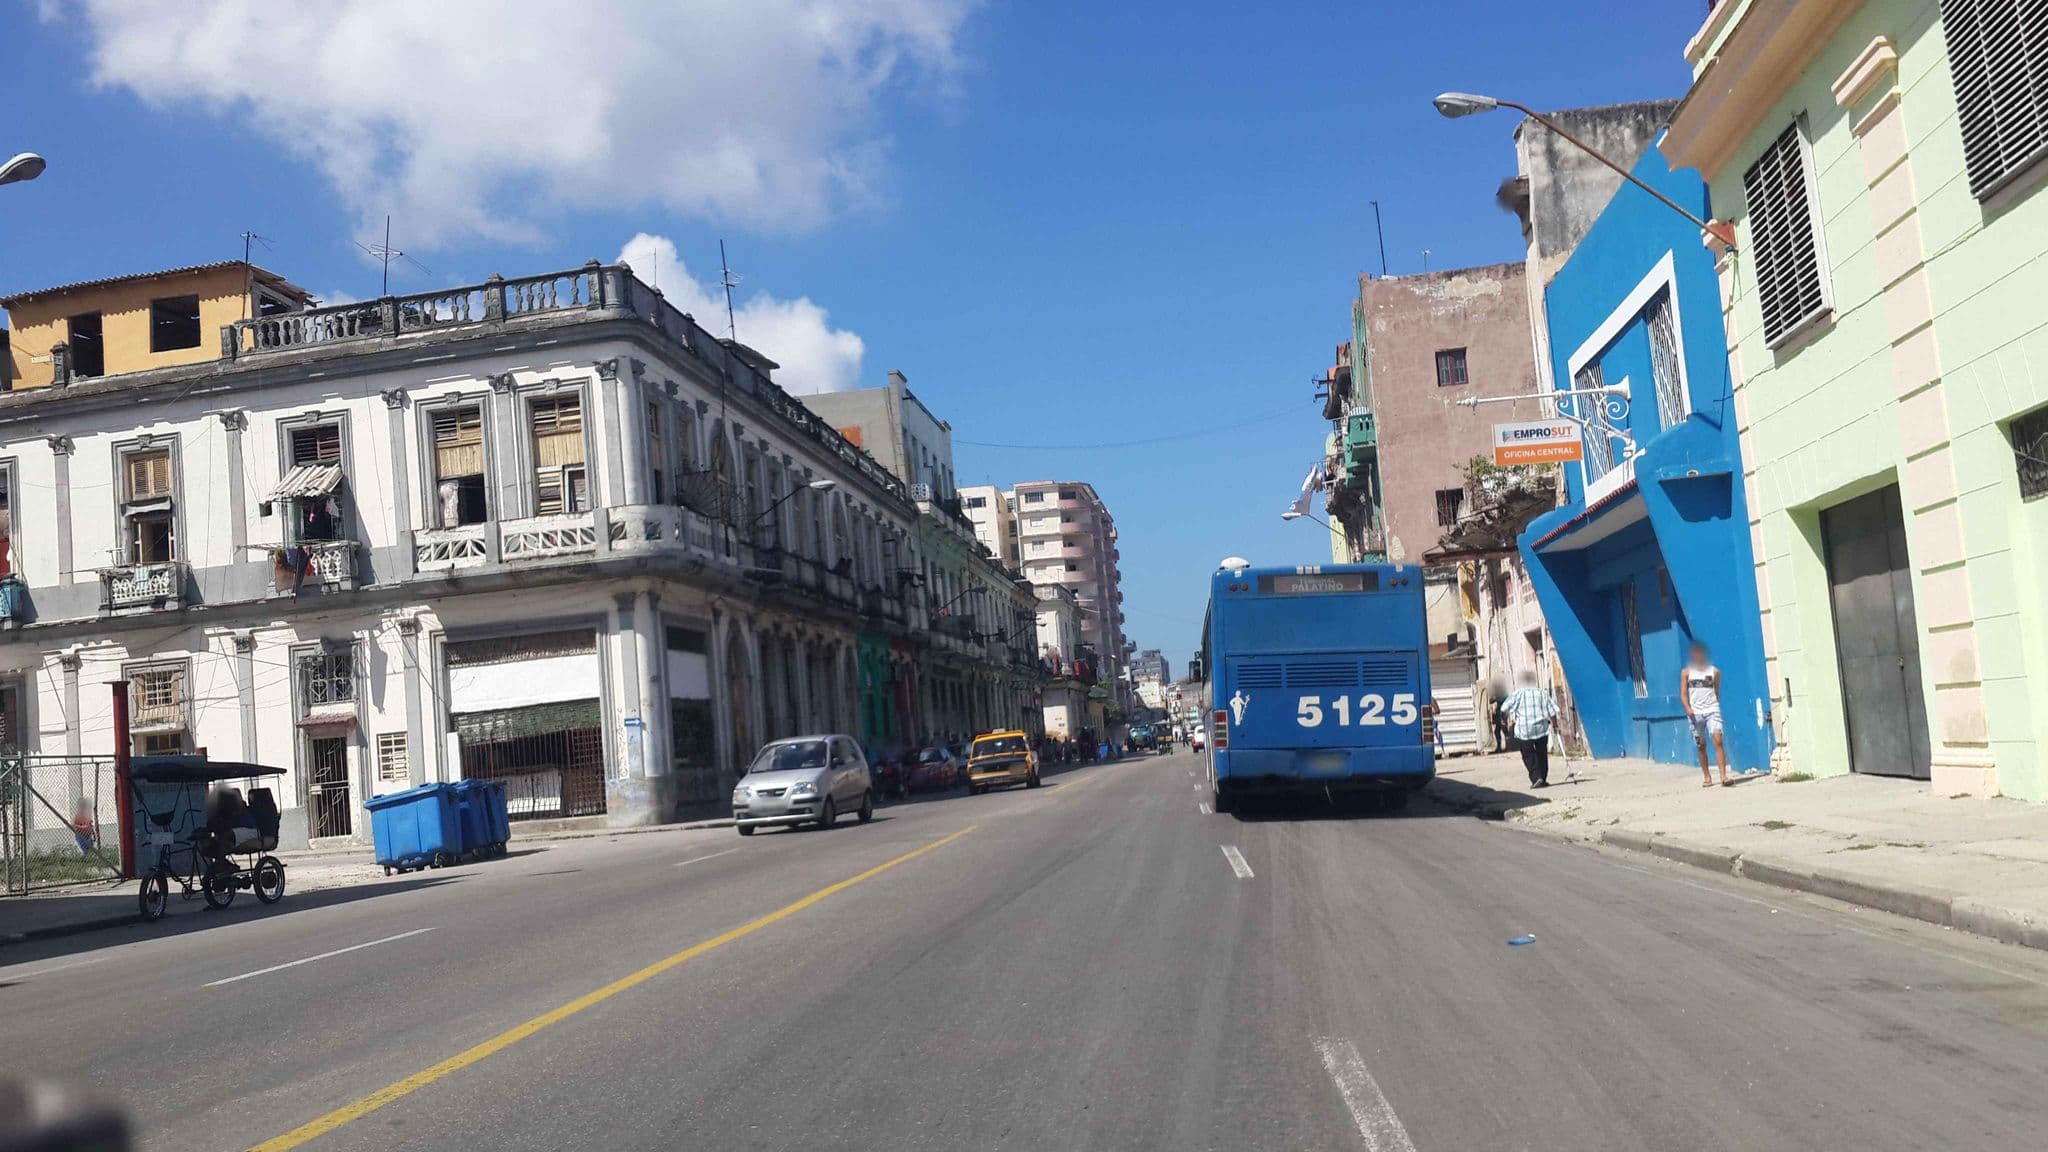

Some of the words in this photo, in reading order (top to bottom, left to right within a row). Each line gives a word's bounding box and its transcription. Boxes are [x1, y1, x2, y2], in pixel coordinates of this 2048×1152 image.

[1514, 426, 1572, 439] EMPROSUT
[1504, 449, 1536, 459] OFICINA
[1537, 447, 1574, 458] CENTRAL
[1291, 583, 1344, 592] PALATINO
[1297, 693, 1418, 728] 5125
